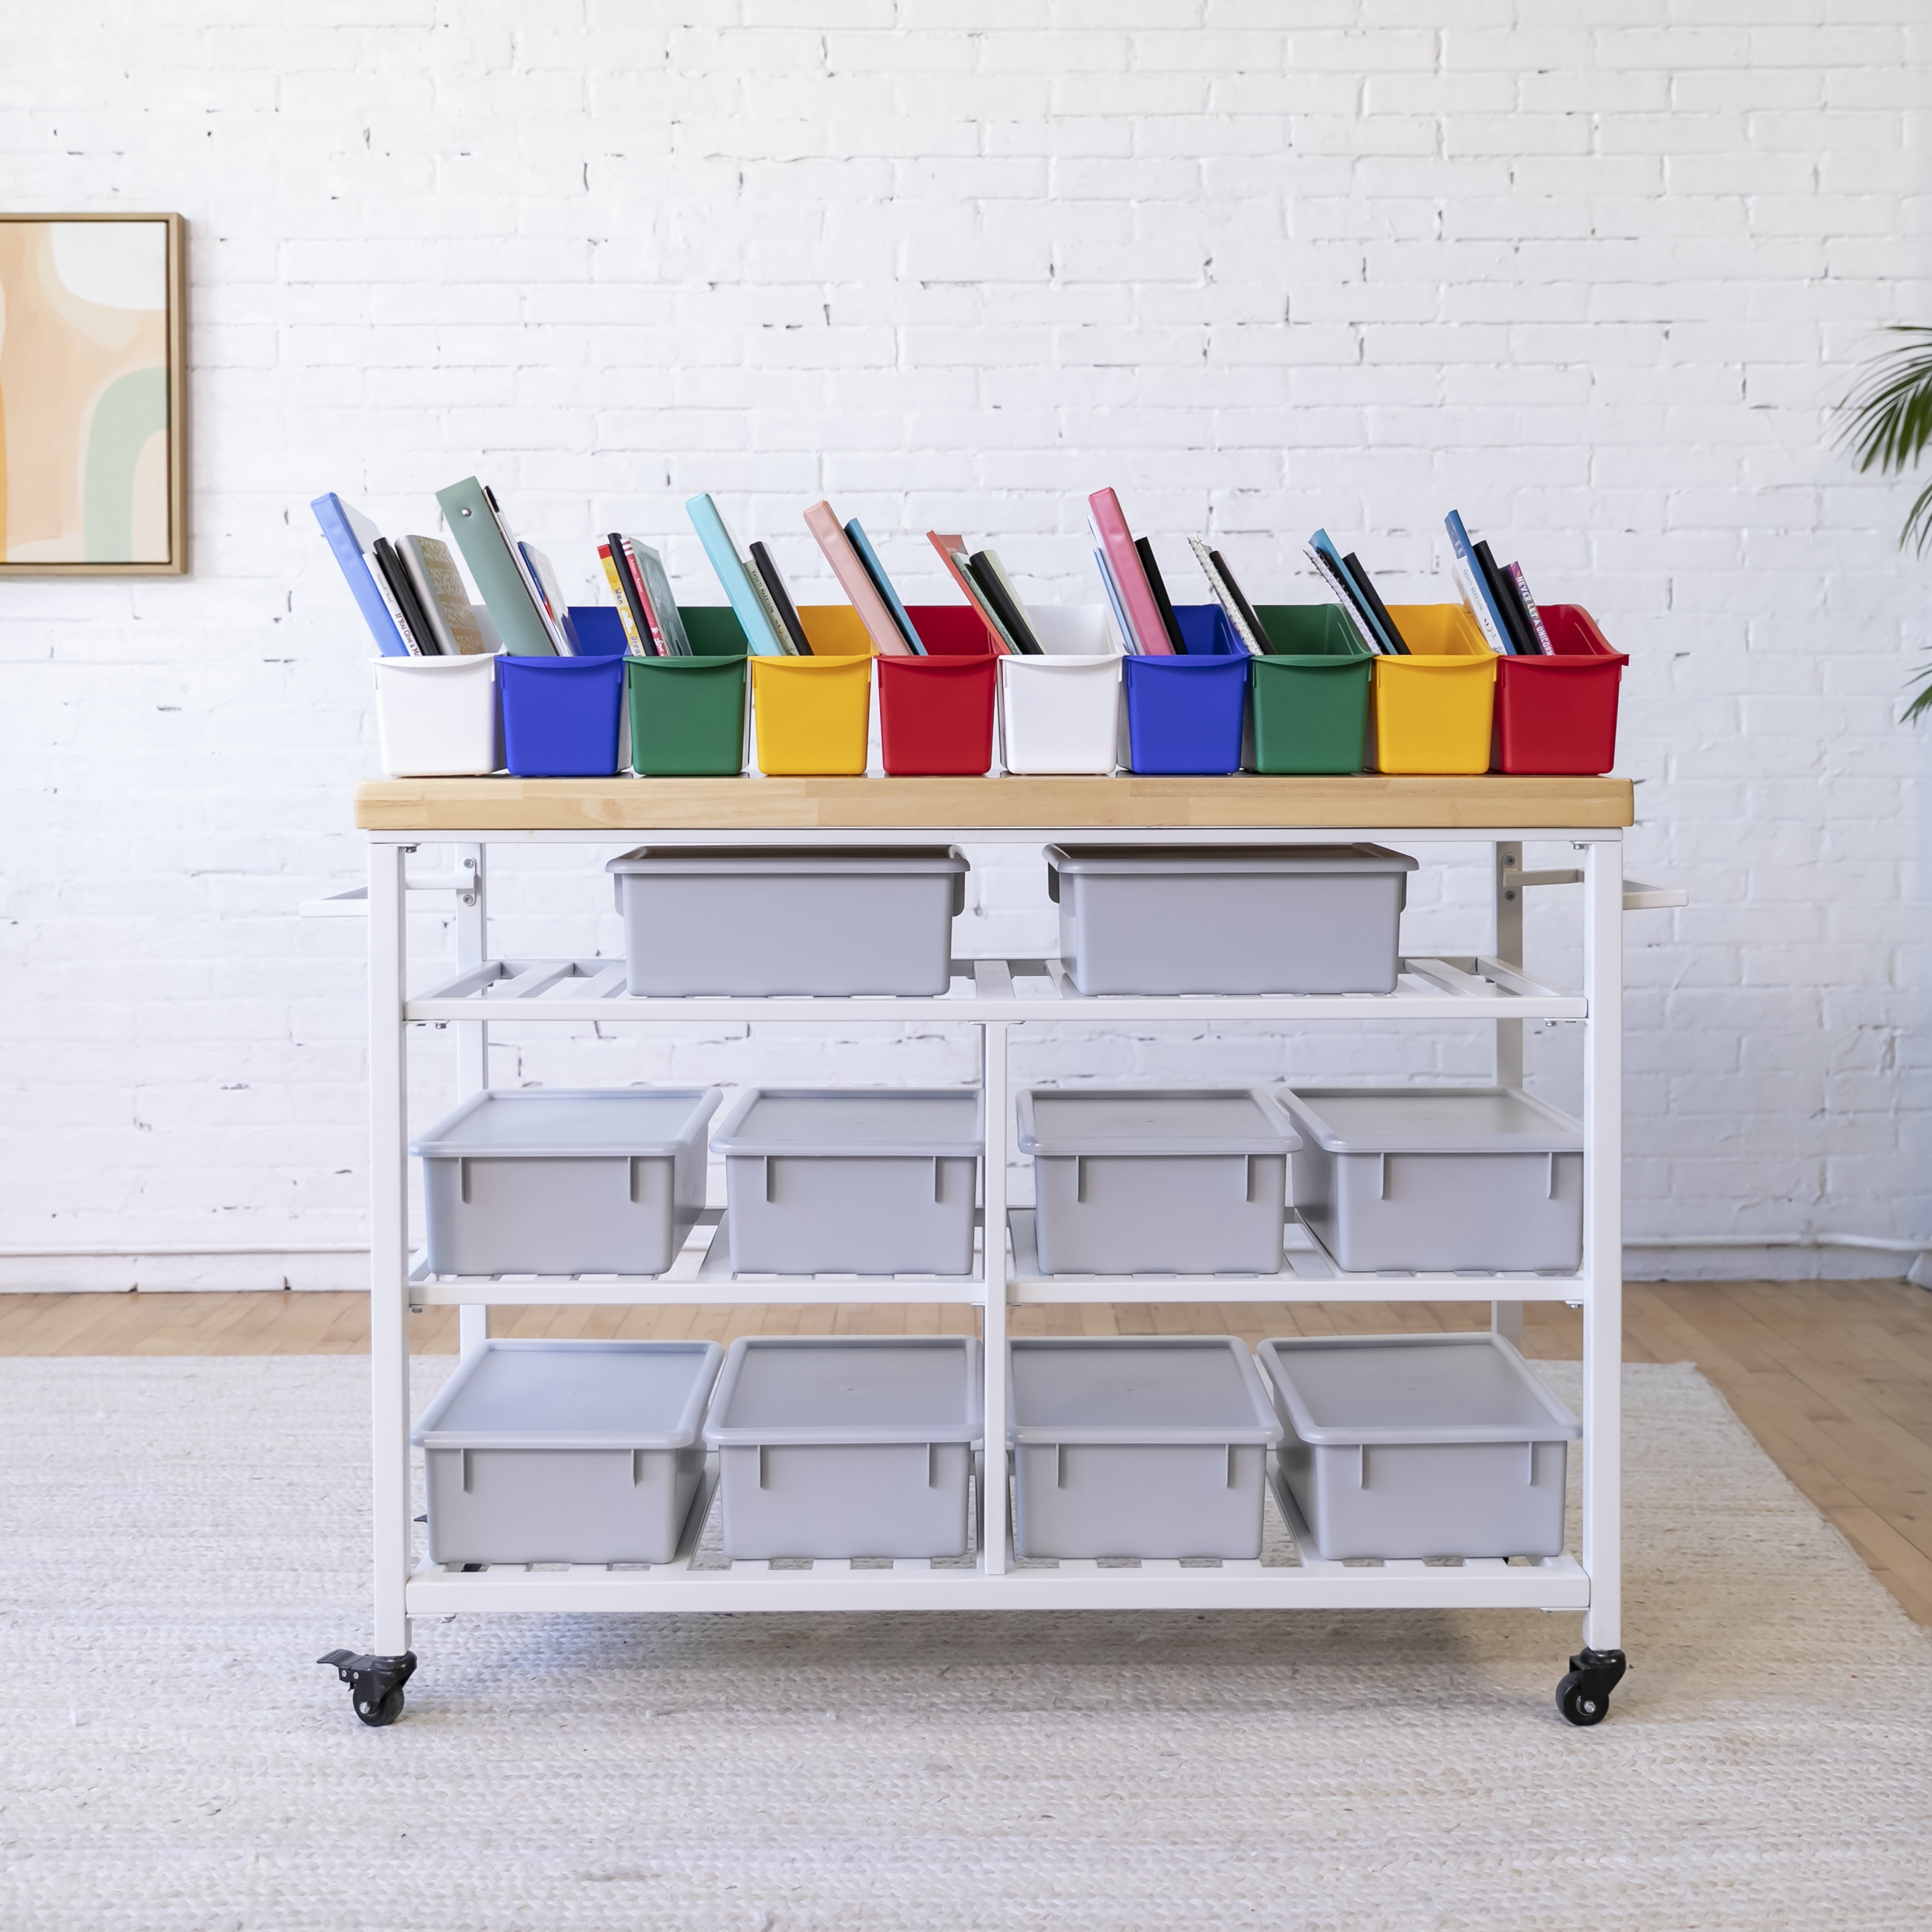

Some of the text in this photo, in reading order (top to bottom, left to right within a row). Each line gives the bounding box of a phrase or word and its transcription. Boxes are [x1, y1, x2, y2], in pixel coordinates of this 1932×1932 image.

[614, 587, 623, 604] Wan
[752, 569, 774, 613] VASHTI HARRISON
[1463, 568, 1483, 611] VASHTI HARRISON
[404, 630, 412, 643] Give
[1516, 575, 1532, 603] NEVER
[1527, 603, 1539, 618] LET
[1536, 626, 1554, 656] UNICORN
